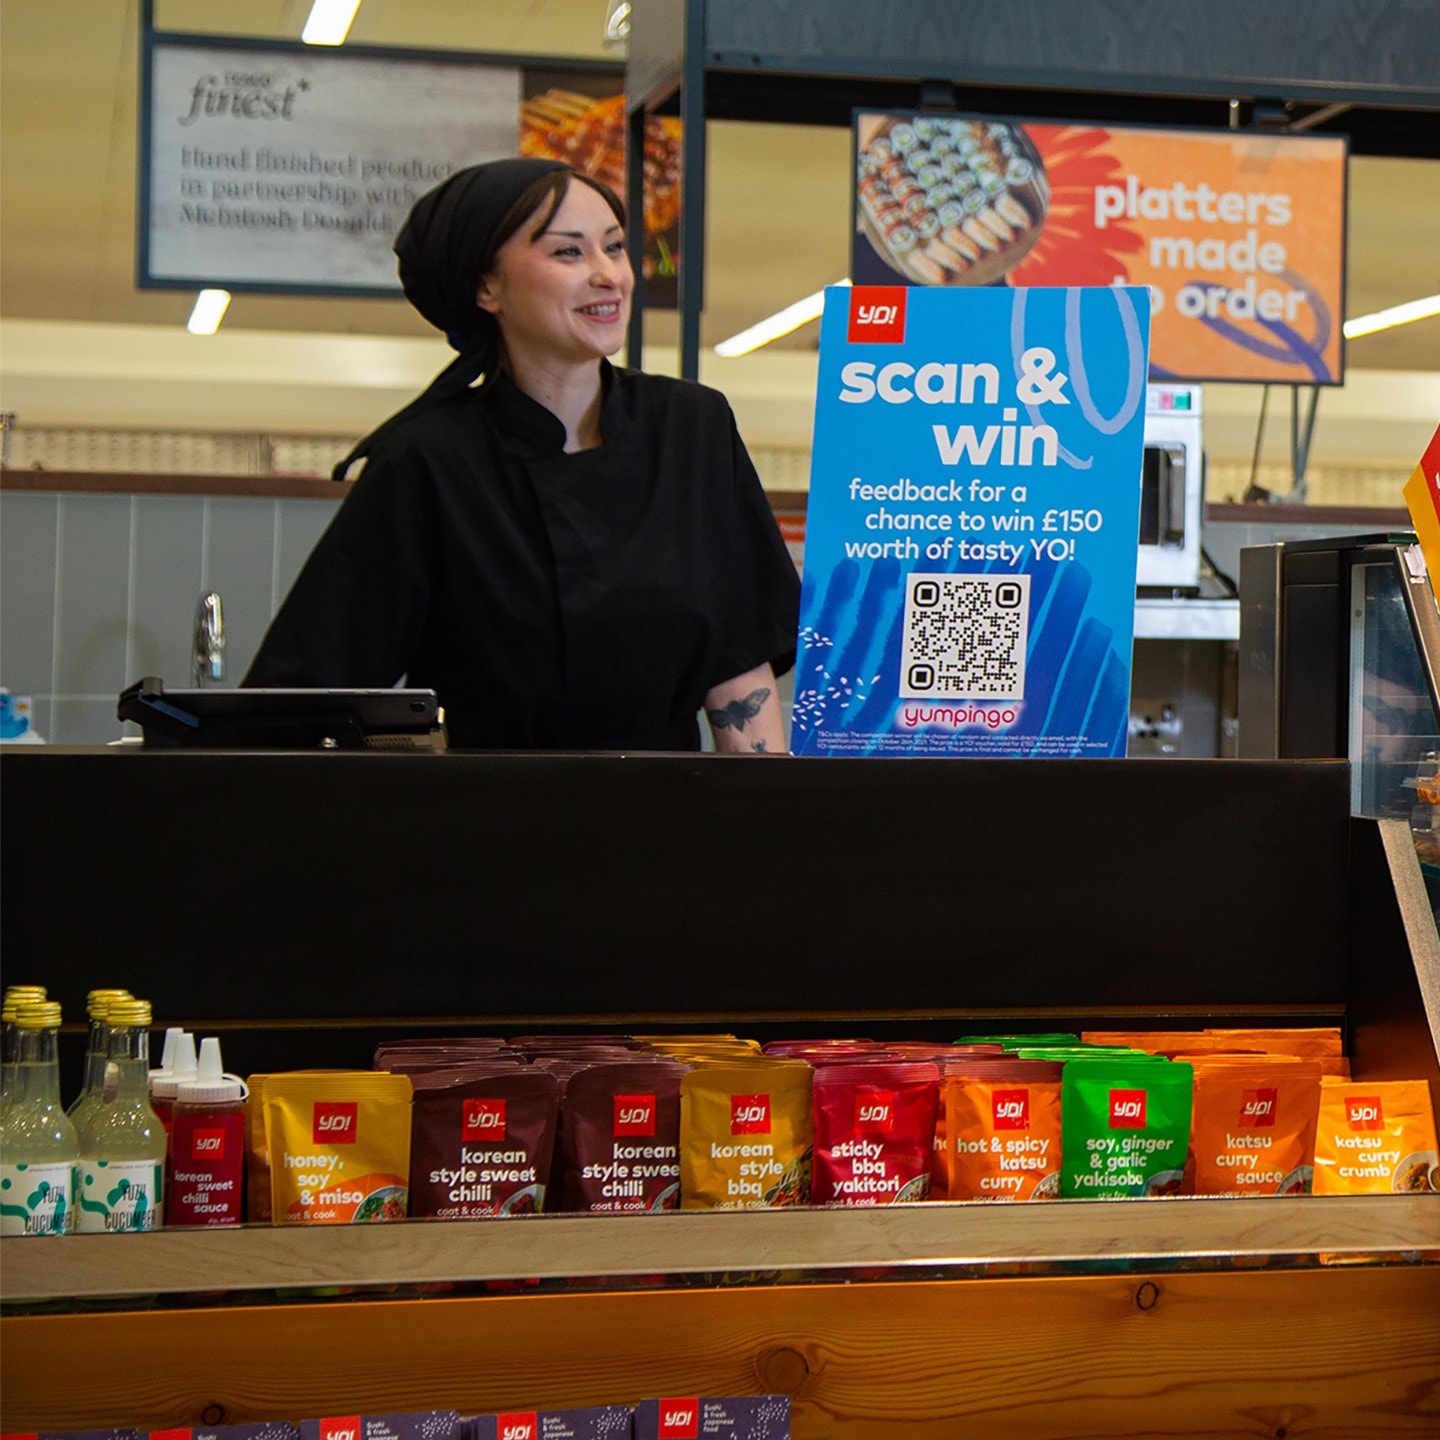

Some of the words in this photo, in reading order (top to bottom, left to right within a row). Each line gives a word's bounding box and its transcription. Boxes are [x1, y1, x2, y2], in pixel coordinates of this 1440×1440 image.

[177, 74, 297, 127] finest
[181, 145, 249, 171] Hand
[256, 147, 354, 174] finished
[361, 156, 462, 181] product
[181, 176, 204, 198] in
[212, 178, 356, 206] partnership
[366, 182, 418, 205] with
[1095, 175, 1291, 228] platters
[1151, 229, 1286, 272] made
[1176, 278, 1306, 322] order
[856, 306, 897, 325] YO!
[839, 361, 999, 404] scan
[1016, 346, 1071, 405] &
[932, 407, 1059, 467] win
[849, 477, 963, 502] feedback
[968, 479, 1005, 502] for
[1011, 485, 1027, 502] a
[865, 507, 952, 531] chance
[959, 511, 986, 531] to
[992, 509, 1034, 532] win
[1042, 509, 1102, 532] £150
[845, 537, 919, 560] worth
[926, 537, 954, 560] of
[958, 540, 1024, 566] tasty
[1030, 538, 1075, 561] YO!
[905, 706, 1015, 729] yumpingo
[618, 1108, 650, 1124] YO!
[734, 1106, 766, 1123] YO!
[860, 1106, 888, 1121] YO!
[996, 1102, 1023, 1118] YO!
[1114, 1102, 1141, 1117] YO!
[1244, 1101, 1272, 1116] YO!
[1351, 1107, 1377, 1122] YO!
[318, 1115, 351, 1130] YO!
[467, 1113, 499, 1129] YO!
[196, 1138, 221, 1150] YO!
[957, 1138, 986, 1153] hot
[991, 1137, 1002, 1152] &
[1006, 1137, 1050, 1156] spicy
[1086, 1137, 1119, 1153] soy,
[1122, 1137, 1173, 1152] ginger
[1226, 1134, 1272, 1149] katsu
[1335, 1134, 1381, 1148] katsu
[461, 1147, 526, 1164] korean
[613, 1143, 676, 1159] korean
[711, 1143, 773, 1159] korean
[832, 1141, 883, 1159] sticky
[1358, 1150, 1400, 1164] curry
[284, 1152, 343, 1171] honey,
[740, 1161, 783, 1177] style
[852, 1159, 886, 1177] bbq
[1000, 1155, 1046, 1171] katsu
[1090, 1154, 1102, 1168] &
[1107, 1153, 1147, 1171] garlic
[1216, 1154, 1259, 1169] curry
[175, 1170, 212, 1182] korean
[430, 1168, 477, 1184] style
[480, 1166, 536, 1182] sweet
[582, 1164, 628, 1180] style
[631, 1163, 680, 1178] swee
[1074, 1170, 1143, 1188] yakisoba
[1236, 1170, 1282, 1184] sauce
[1339, 1164, 1390, 1178] crumb
[197, 1180, 233, 1191] sweet
[297, 1174, 330, 1190] soy
[602, 1181, 643, 1197] chilli
[728, 1179, 762, 1198] bbq
[833, 1176, 899, 1197] yakitori
[980, 1176, 1023, 1192] curry
[182, 1193, 209, 1203] chilli
[300, 1189, 314, 1205] &
[319, 1188, 363, 1205] miso
[449, 1184, 491, 1202] chilli
[194, 1203, 229, 1213] sauce
[470, 1206, 494, 1215] cook
[591, 1202, 611, 1211] coat
[623, 1201, 646, 1210] cook
[313, 1210, 337, 1219] cook
[664, 1411, 693, 1426] YO!
